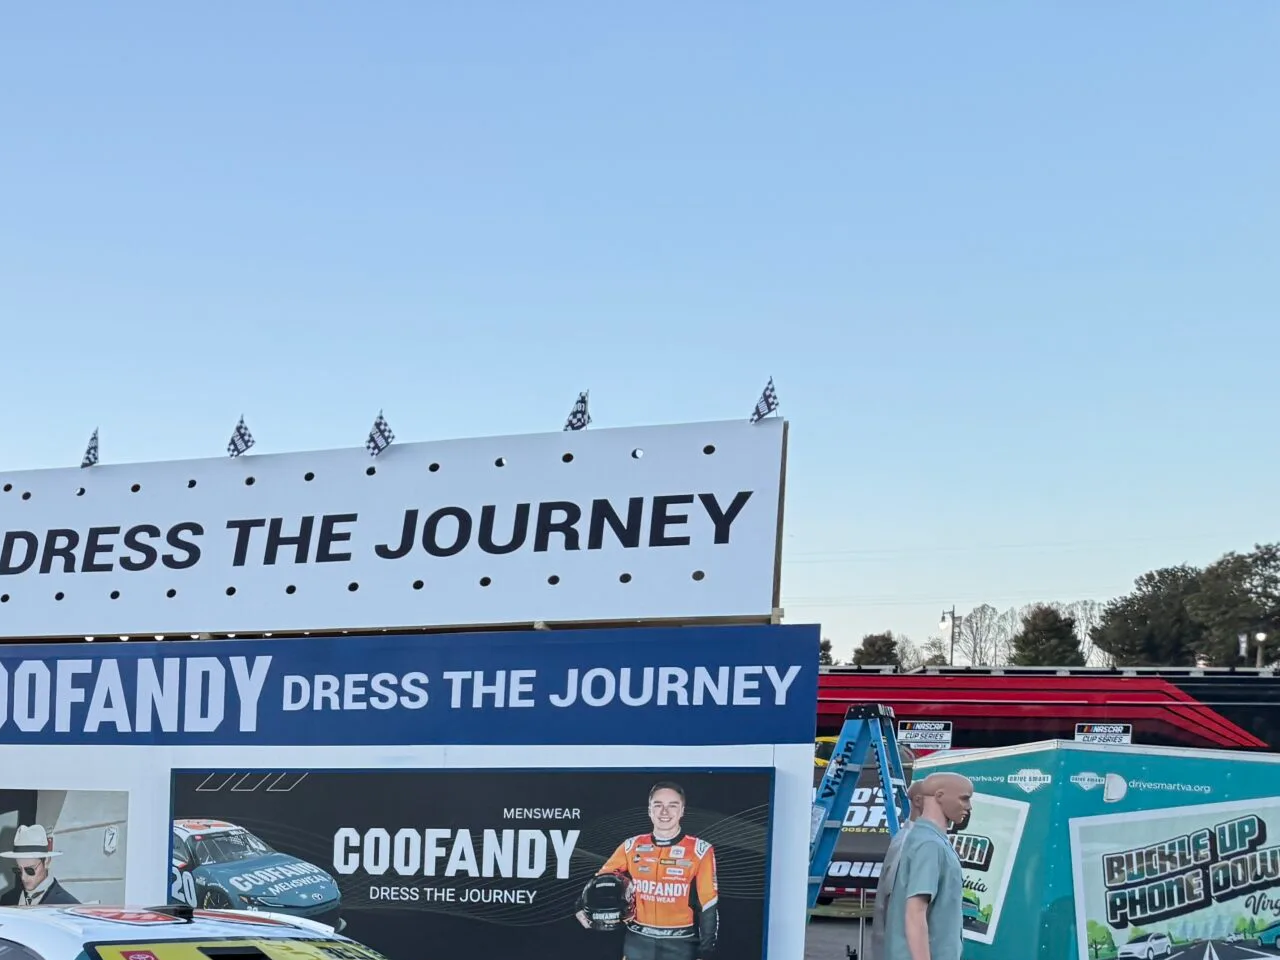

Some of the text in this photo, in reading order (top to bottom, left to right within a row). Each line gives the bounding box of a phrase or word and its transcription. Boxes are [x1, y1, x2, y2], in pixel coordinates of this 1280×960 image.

[224, 513, 359, 567] THE
[374, 490, 753, 560] JOURNEY
[282, 672, 430, 711] DRESS
[442, 669, 535, 708] THE
[549, 664, 801, 706] JOURNEY
[1128, 779, 1212, 794] drivesmartva.org
[503, 808, 580, 820] MENSWEAR
[333, 827, 581, 880] COOFANDY
[1104, 815, 1259, 888] BUCKLE UP
[171, 866, 198, 909] 20
[369, 886, 537, 904] DRESS THE JOURNEY
[1107, 848, 1280, 924] PHONE DOW
